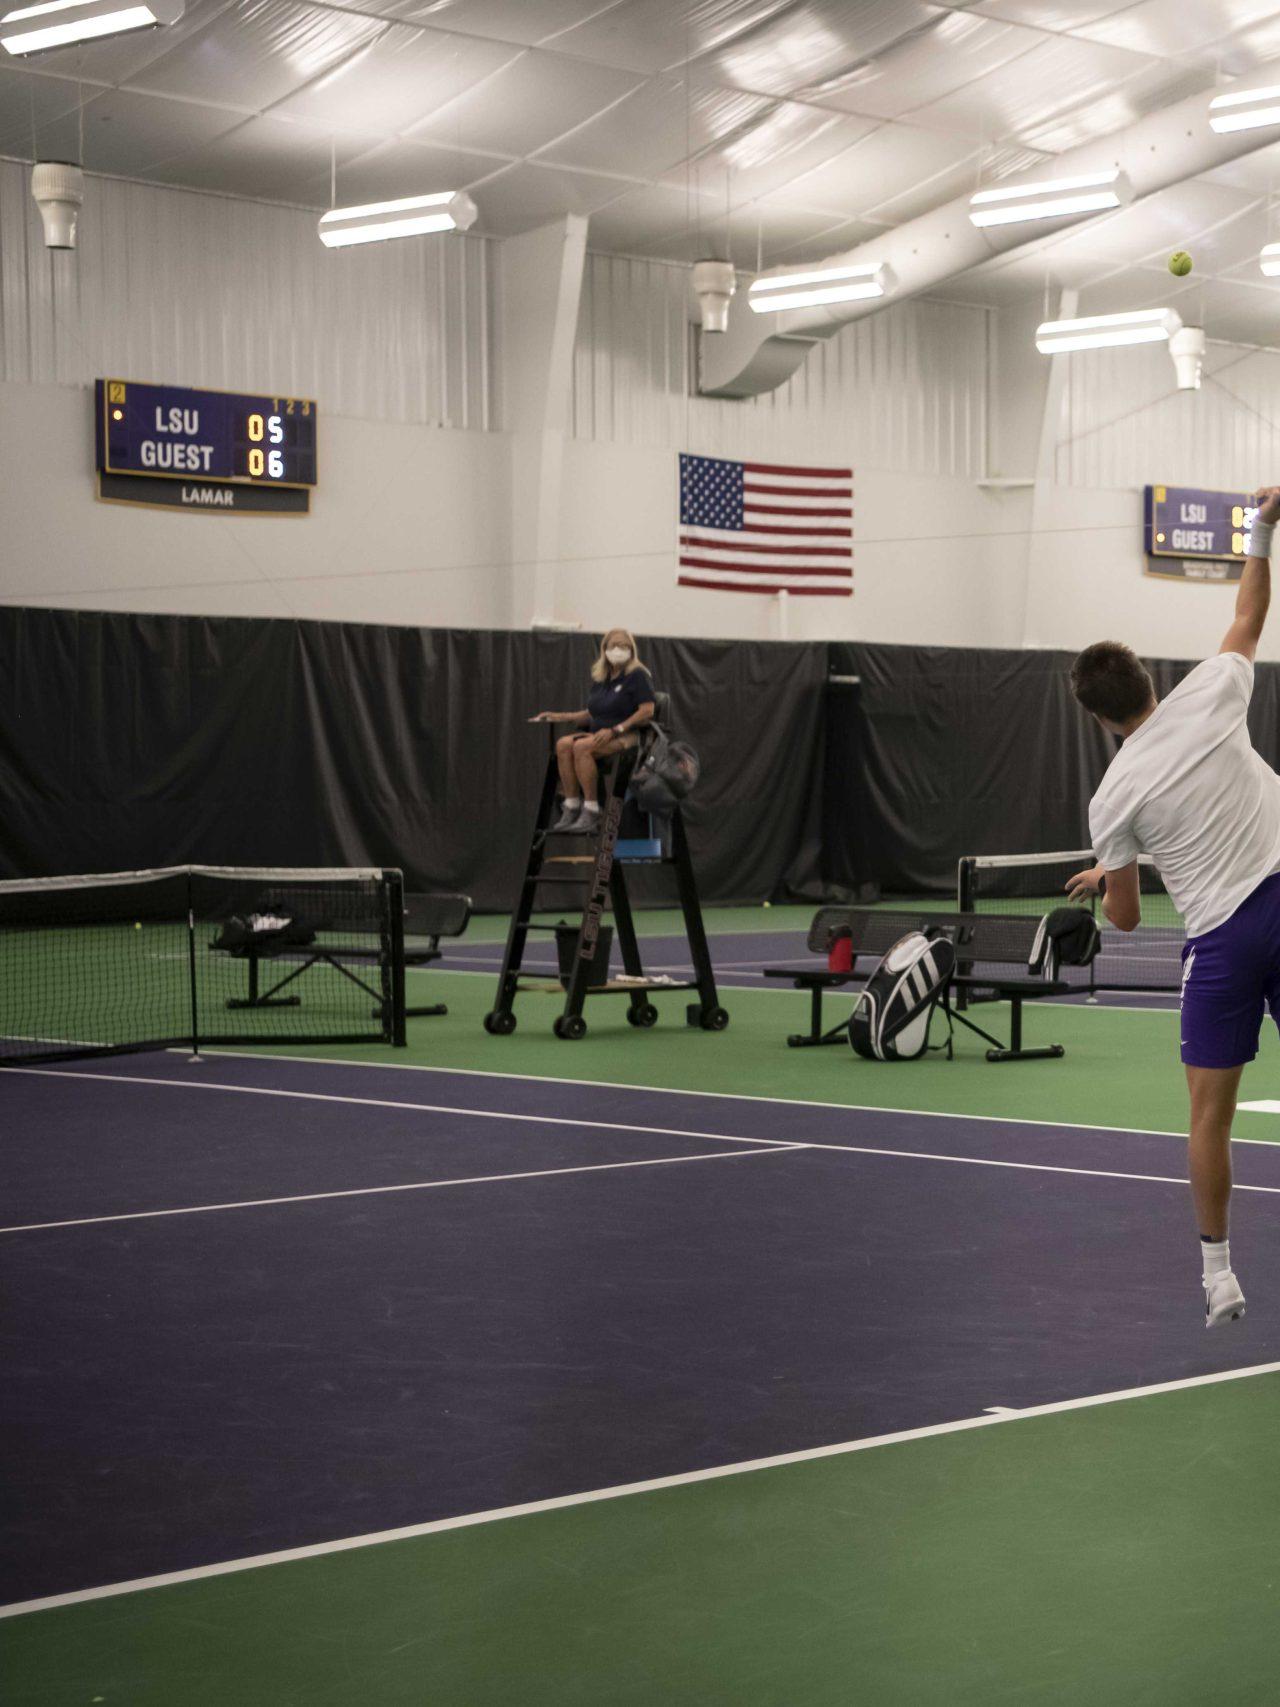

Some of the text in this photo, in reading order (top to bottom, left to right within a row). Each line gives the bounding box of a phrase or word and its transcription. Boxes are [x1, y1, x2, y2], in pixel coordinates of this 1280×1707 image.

[154, 406, 199, 435] LSU
[140, 440, 214, 471] GUEST
[181, 487, 234, 506] LAMAR
[1180, 503, 1207, 523] LSU
[1172, 529, 1214, 551] GUEST
